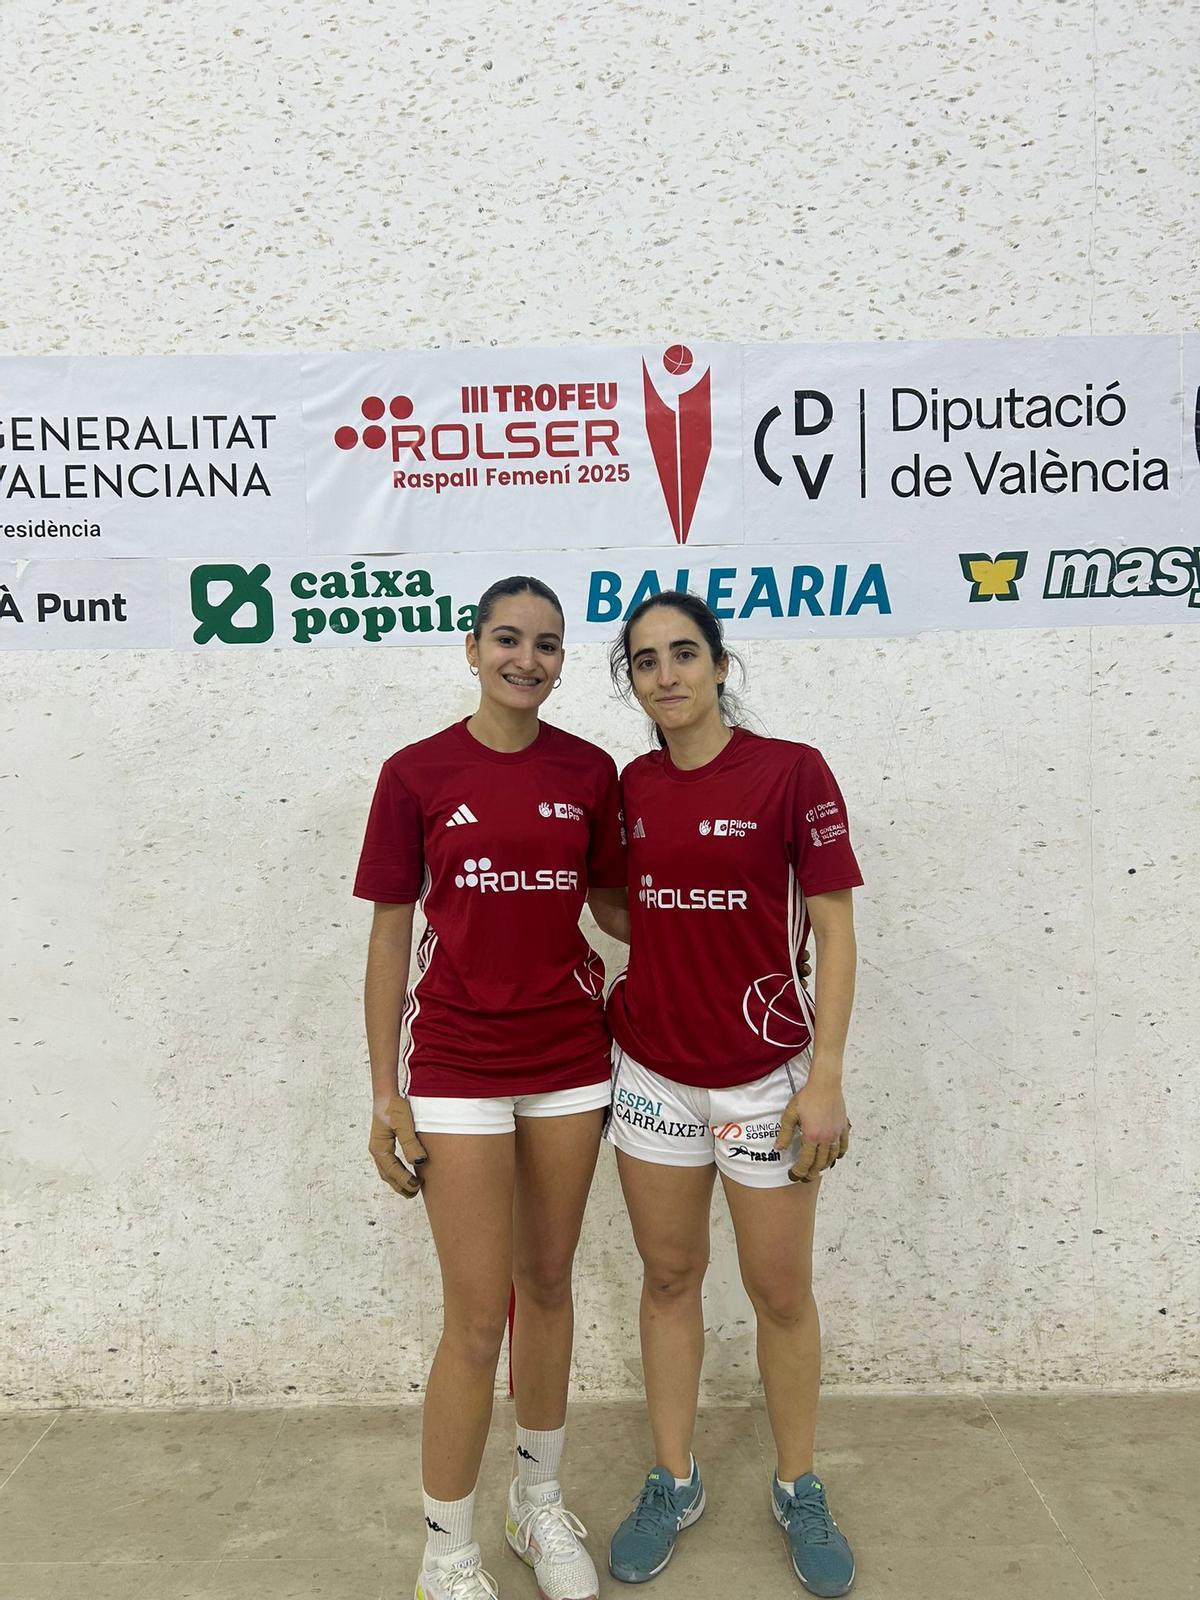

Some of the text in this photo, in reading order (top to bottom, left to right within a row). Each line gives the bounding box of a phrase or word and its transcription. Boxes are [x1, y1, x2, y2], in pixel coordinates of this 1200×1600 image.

[461, 382, 618, 413] III TROFEU
[892, 381, 1127, 443] Diputació
[391, 419, 620, 462] ROLSER
[393, 463, 631, 494] Raspall Femení 2025
[892, 448, 1169, 498] de València
[290, 561, 434, 600] caixa
[36, 592, 128, 623] Punt
[568, 811, 580, 821] Pro
[729, 819, 757, 830] Pilota
[728, 828, 746, 837] Pro
[479, 870, 578, 893] ROLSER
[646, 888, 748, 910] ROLSER
[617, 1088, 663, 1117] ESPAI
[614, 1103, 711, 1138] CARRAIXET
